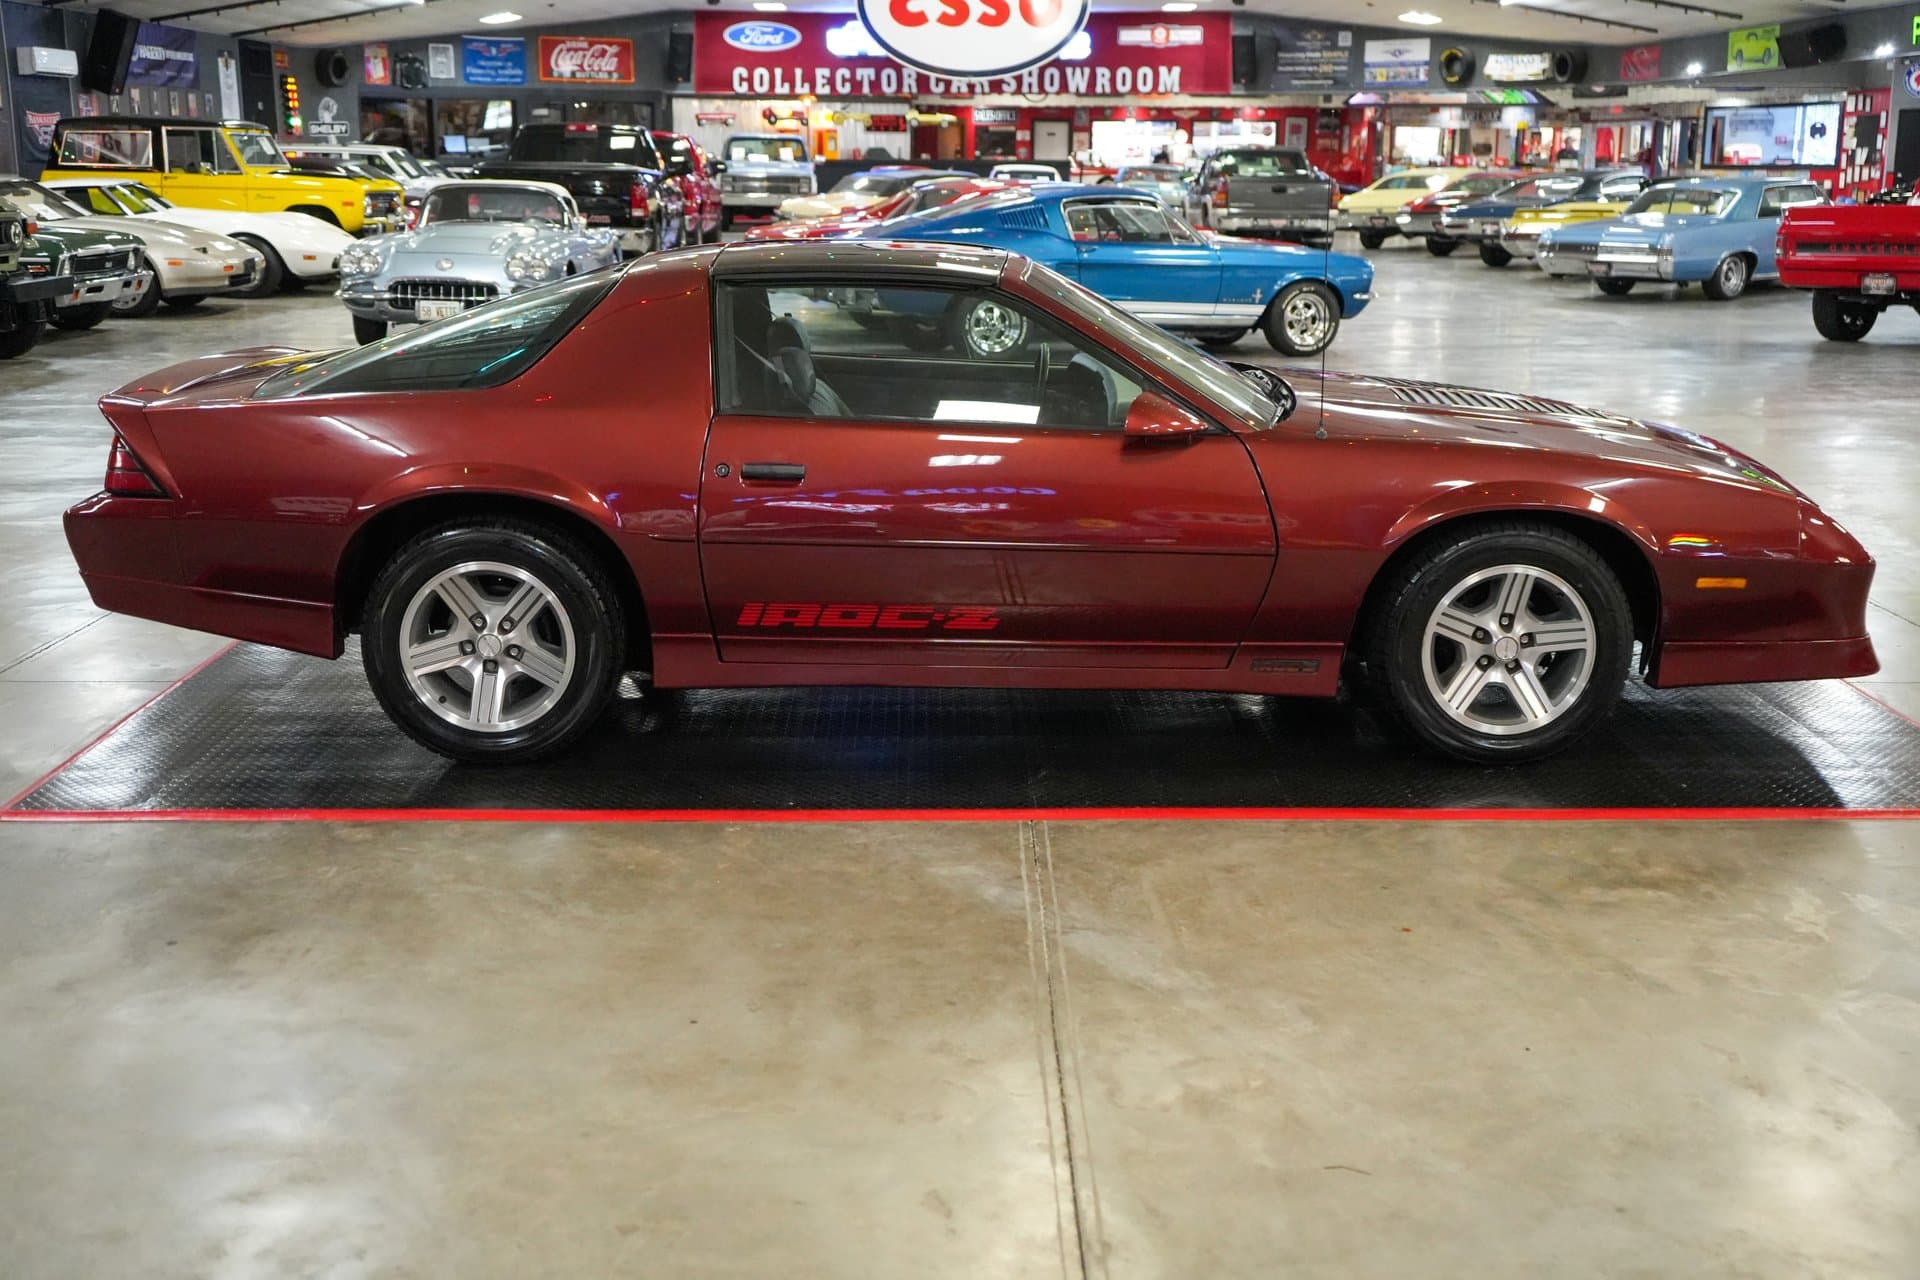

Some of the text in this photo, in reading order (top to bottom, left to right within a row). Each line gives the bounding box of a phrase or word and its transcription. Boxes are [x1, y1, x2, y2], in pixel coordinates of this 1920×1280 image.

[739, 26, 784, 45] Ford
[550, 43, 620, 71] Coca-Cola
[732, 66, 917, 95] COLLECTOR
[1001, 66, 1181, 95] SHOWROOM
